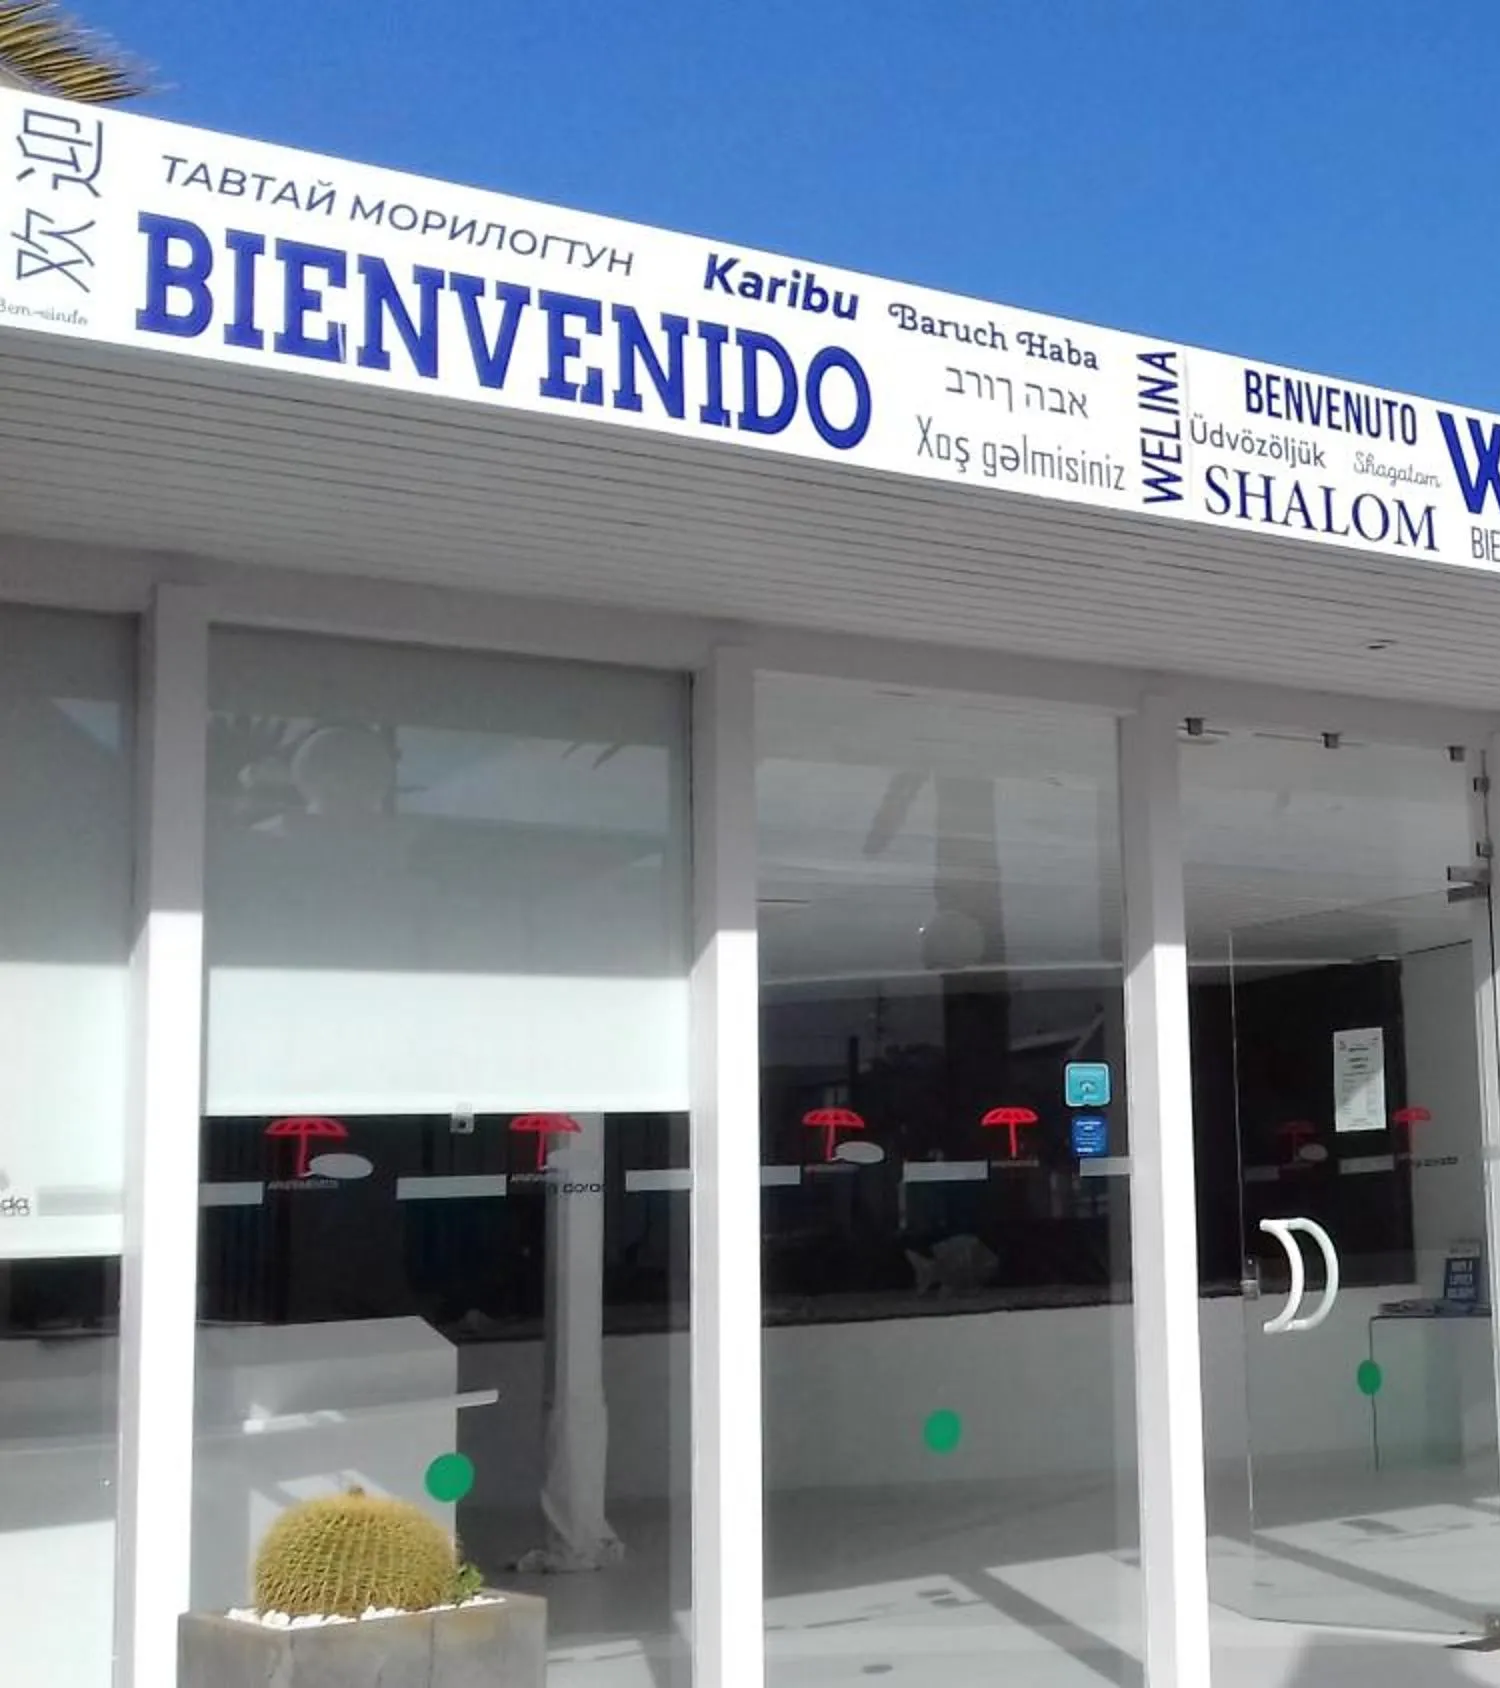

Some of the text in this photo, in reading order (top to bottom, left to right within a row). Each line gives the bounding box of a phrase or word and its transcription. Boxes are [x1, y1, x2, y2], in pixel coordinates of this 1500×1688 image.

[11, 109, 103, 293] 欢迎
[162, 154, 634, 277] ТАВТАЙ МОРИЛОГТУН
[135, 210, 872, 450] BIENVENIDO
[703, 252, 859, 321] Karibu
[887, 302, 1099, 371] Baruch Haba
[1136, 351, 1184, 504] WELINA
[1190, 412, 1326, 469] Üdvözöljük
[1244, 368, 1418, 446] BENVENUTO
[1204, 464, 1441, 551] SHALOM
